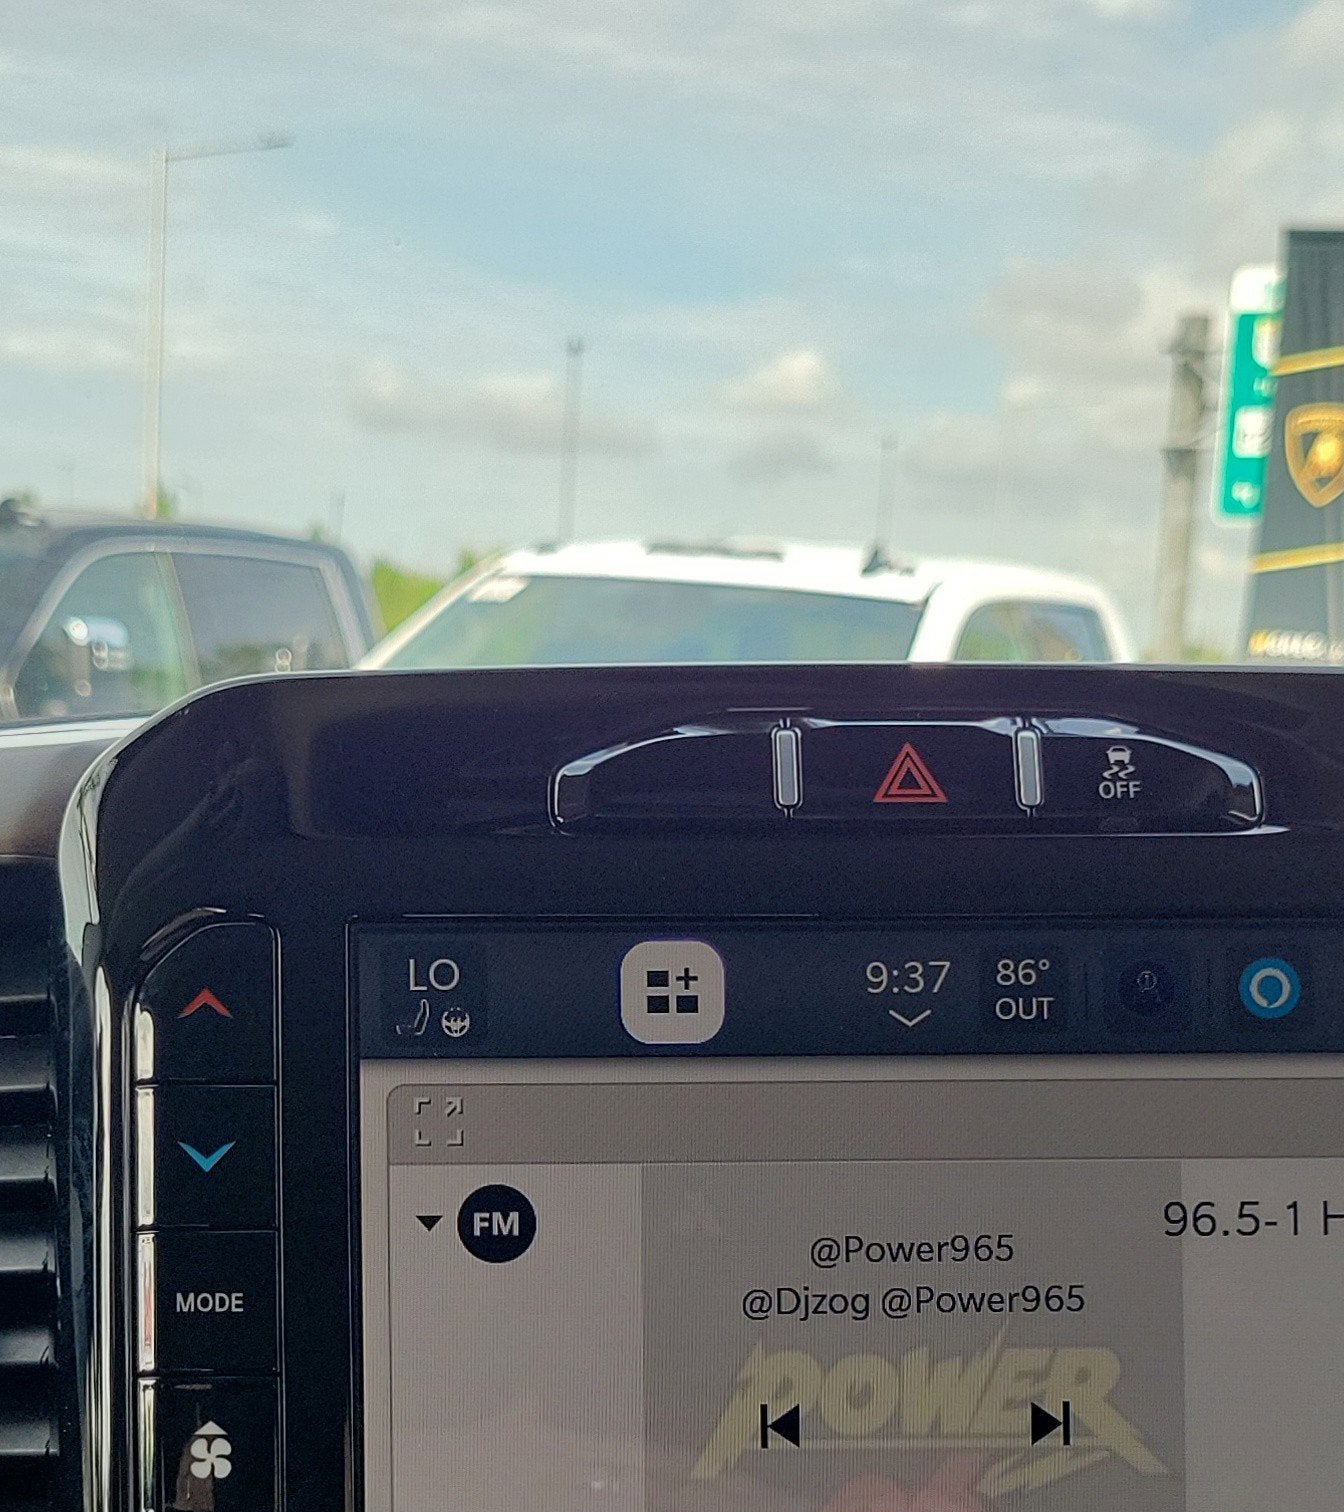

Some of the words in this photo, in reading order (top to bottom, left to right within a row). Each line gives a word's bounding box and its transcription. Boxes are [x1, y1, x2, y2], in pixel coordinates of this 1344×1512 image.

[1098, 781, 1142, 799] OFF
[409, 958, 460, 991] LO
[866, 961, 950, 994] 9:37
[996, 958, 1050, 986] 86°
[995, 998, 1054, 1021] OUT
[473, 1212, 519, 1236] FM
[1163, 1200, 1299, 1237] 96.5-1
[810, 1234, 1014, 1268] @Power965
[176, 1293, 244, 1313] MODE
[742, 1287, 870, 1321] @Djzog
[881, 1285, 1085, 1319] @Power965
